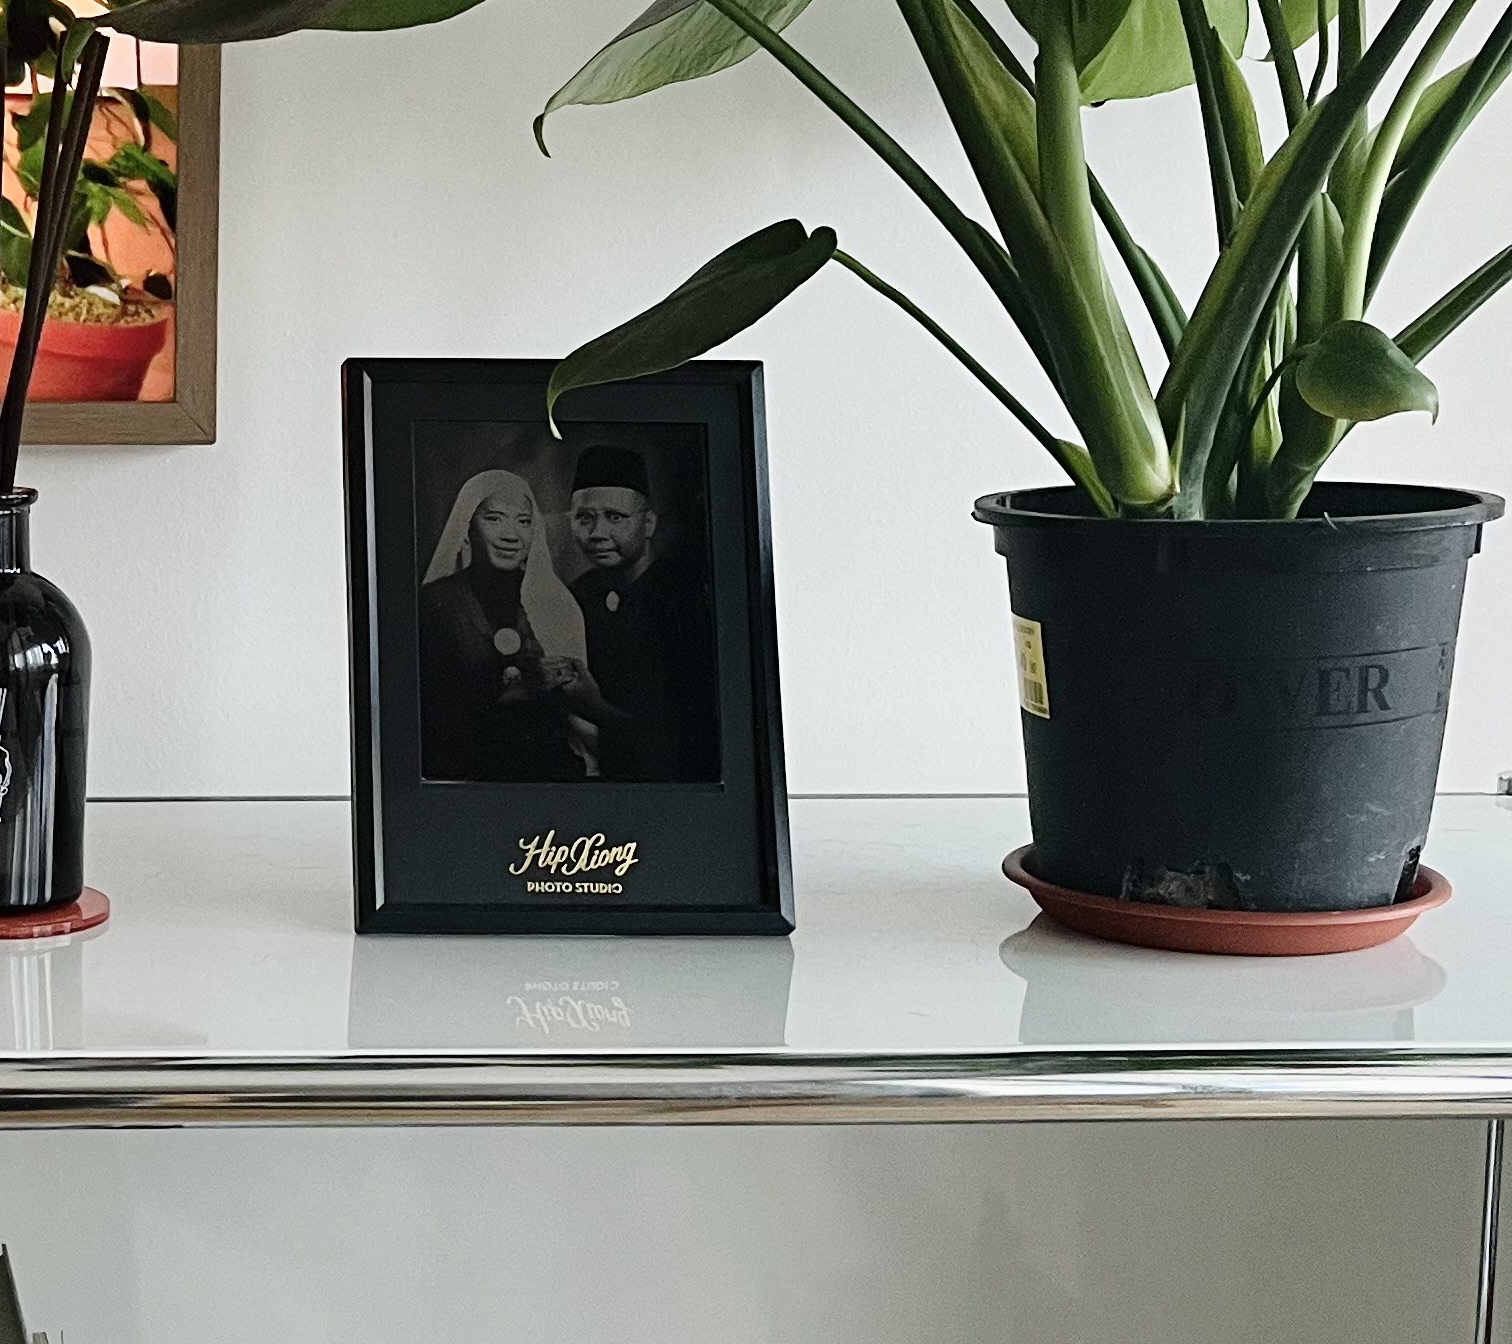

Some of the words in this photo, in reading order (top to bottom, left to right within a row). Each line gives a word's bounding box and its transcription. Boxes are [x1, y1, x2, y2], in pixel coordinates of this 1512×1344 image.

[509, 829, 569, 875] Hip
[527, 881, 573, 893] PHOTO
[574, 881, 623, 894] STUDIO
